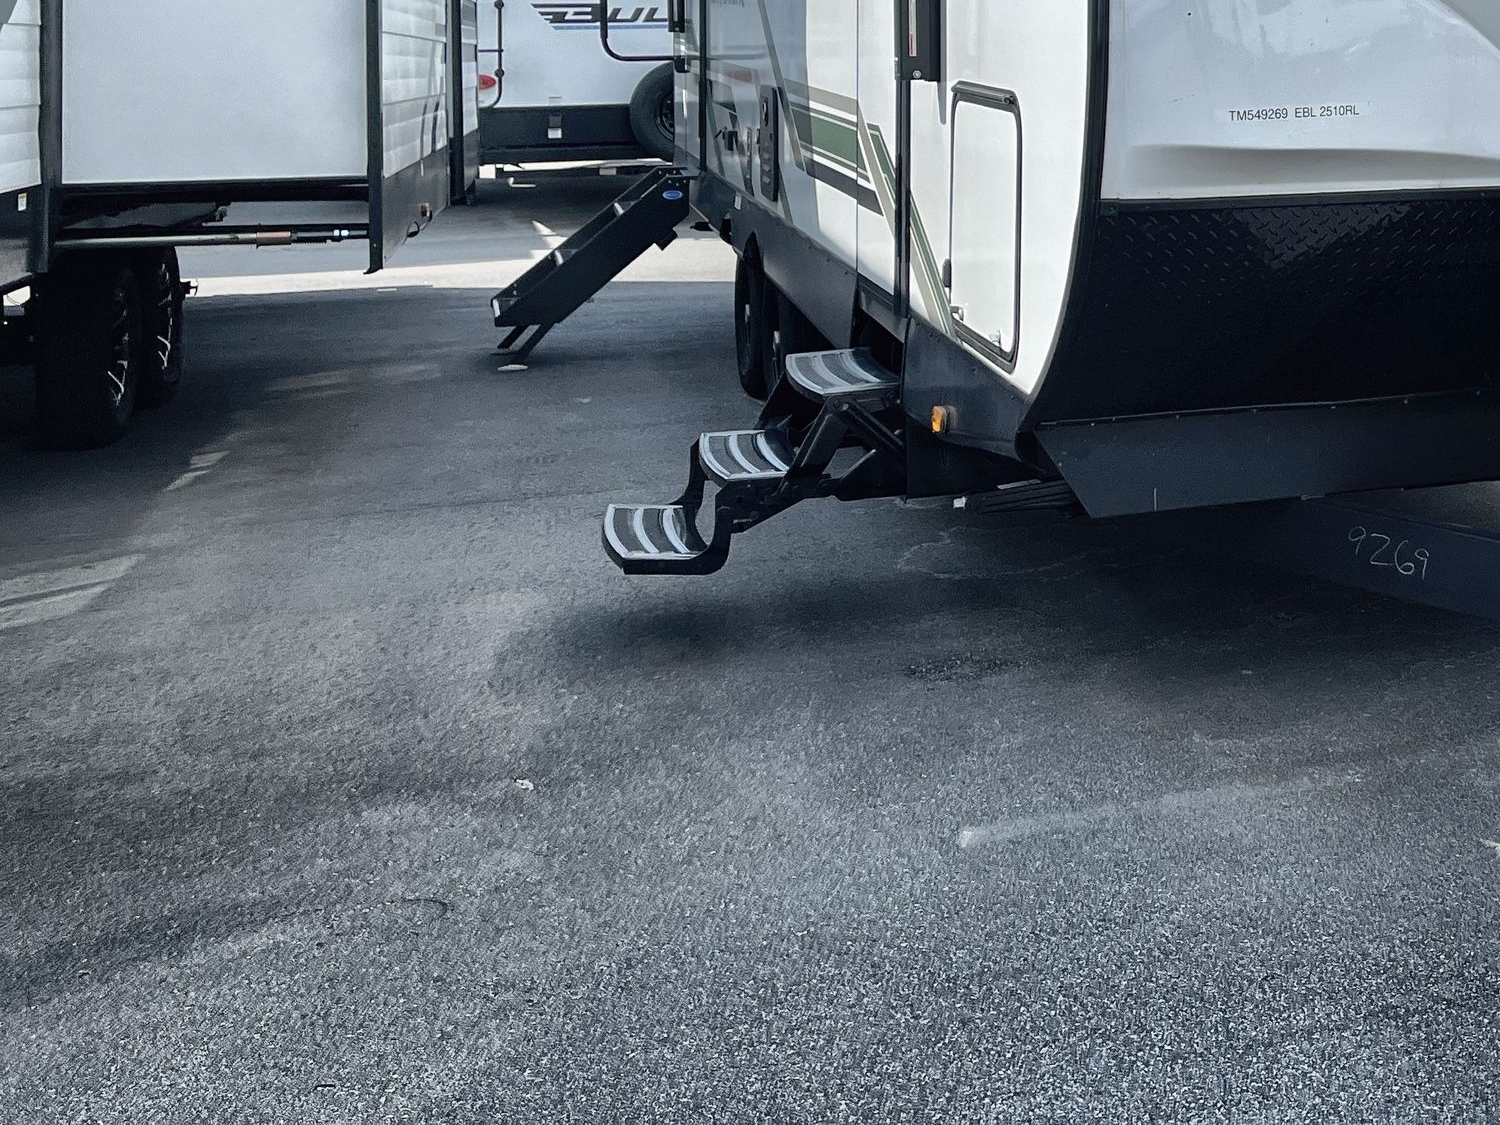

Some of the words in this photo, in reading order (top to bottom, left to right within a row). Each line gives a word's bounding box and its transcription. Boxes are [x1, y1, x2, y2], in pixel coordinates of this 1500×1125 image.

[1228, 107, 1288, 121] TM549269
[1294, 107, 1317, 119] EBL
[1319, 105, 1359, 117] 2510RL
[1348, 525, 1429, 580] 9269
